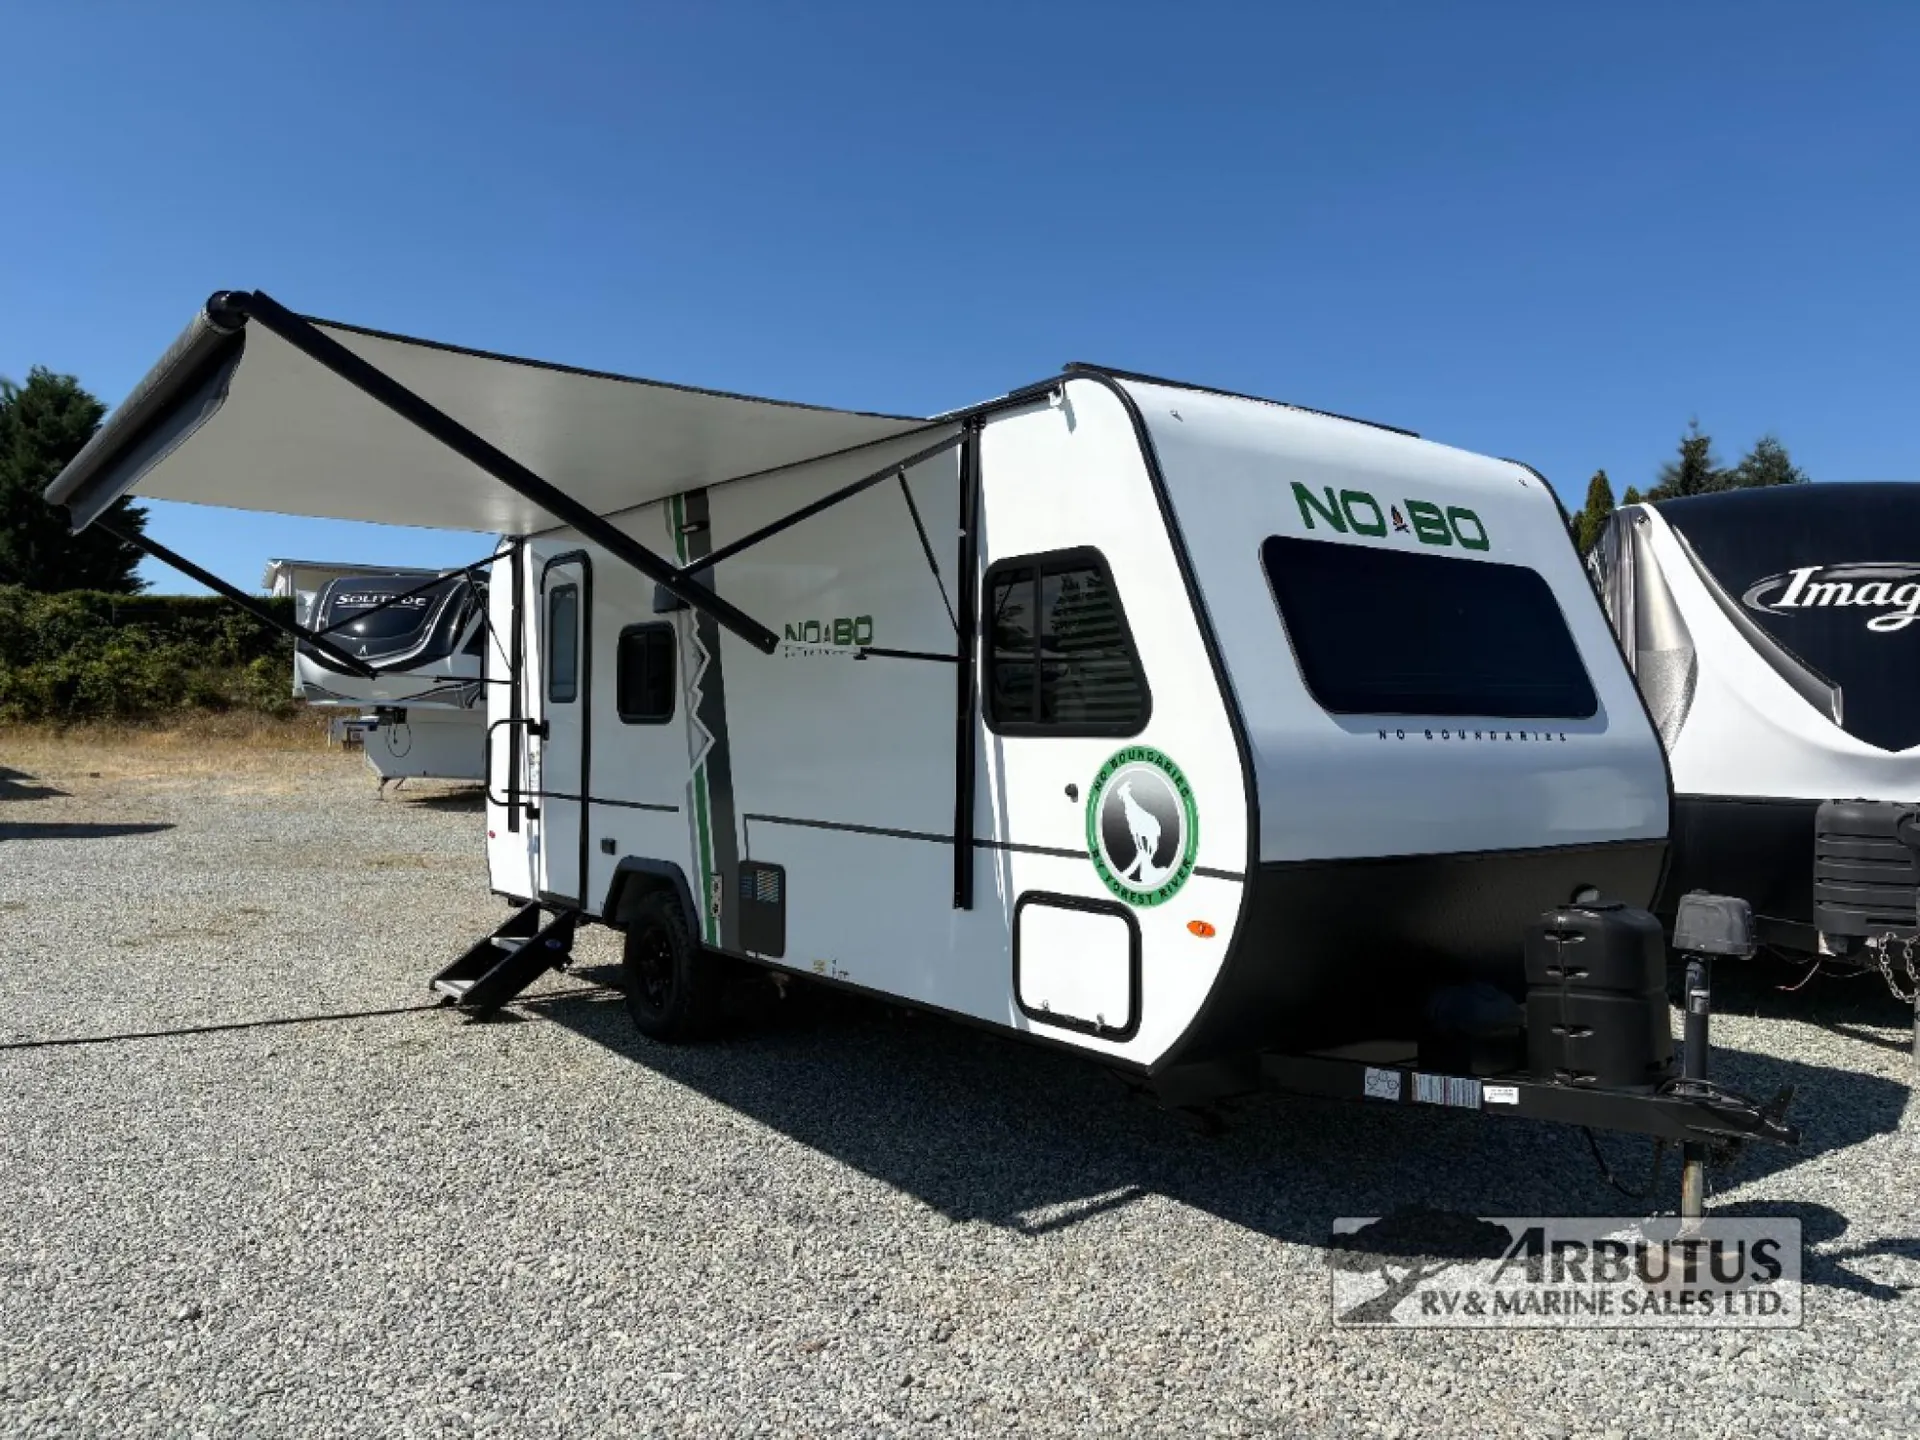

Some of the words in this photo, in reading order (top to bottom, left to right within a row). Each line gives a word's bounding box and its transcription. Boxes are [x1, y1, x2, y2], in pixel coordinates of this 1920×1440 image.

[1290, 481, 1388, 537] NO
[1403, 498, 1490, 551] BO
[335, 593, 427, 606] SOLITDE
[785, 620, 820, 643] NO
[834, 614, 873, 645] BO
[1378, 728, 1405, 740] NO
[1424, 728, 1567, 742] BOUNDARIES
[1094, 770, 1108, 792] NO
[1109, 749, 1190, 798] BOUNDARIES
[1105, 874, 1153, 905] FOREST
[1158, 858, 1192, 898] RIVER
